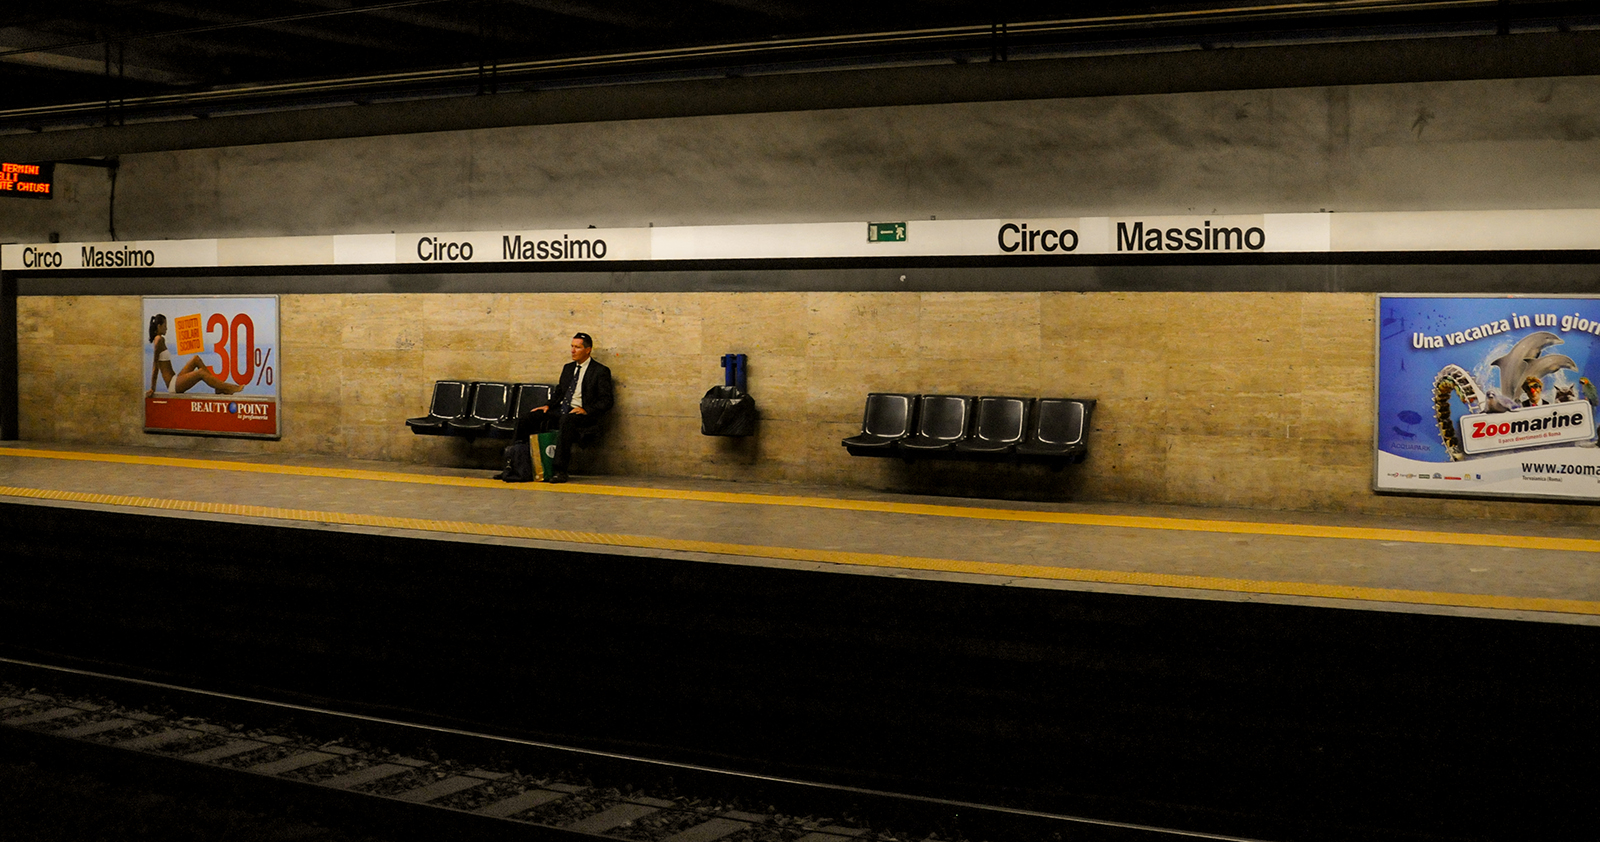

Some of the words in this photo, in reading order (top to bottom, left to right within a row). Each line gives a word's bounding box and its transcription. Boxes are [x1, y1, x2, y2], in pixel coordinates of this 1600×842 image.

[2, 163, 39, 175] TERMINI
[16, 182, 50, 193] CHIUSI
[998, 223, 1078, 252] Circo
[1117, 220, 1265, 251] Massimo
[23, 247, 62, 267] Circo
[82, 245, 155, 267] Massimo
[417, 236, 473, 261] Circo
[502, 234, 607, 260] Massimo
[1413, 332, 1444, 348] Una
[1445, 319, 1511, 346] vacanza
[1512, 312, 1531, 329] in
[1534, 313, 1557, 326] un
[191, 401, 228, 413] BEAUTY
[237, 403, 268, 415] POINT
[1472, 411, 1583, 438] Zoomarine
[1515, 434, 1543, 442] divertimenti
